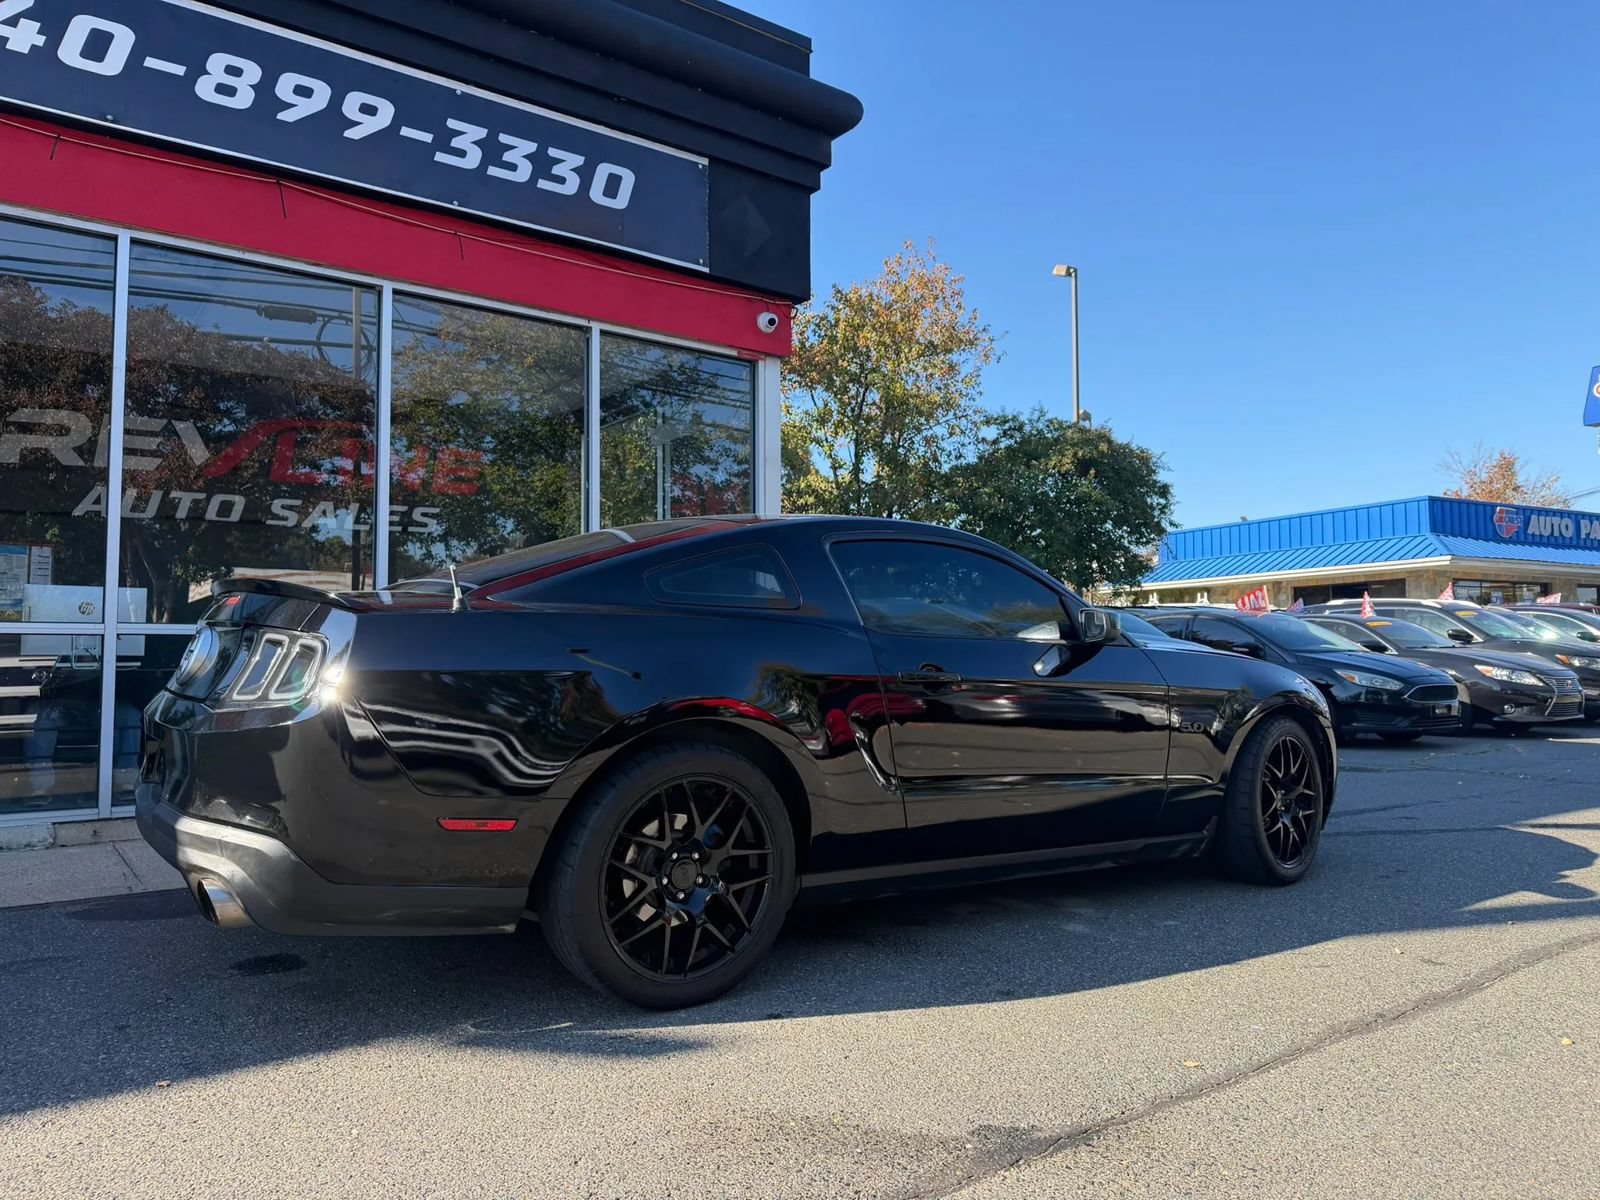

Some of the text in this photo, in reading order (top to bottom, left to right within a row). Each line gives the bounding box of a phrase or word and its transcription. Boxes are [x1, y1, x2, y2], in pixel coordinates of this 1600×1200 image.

[71, 484, 441, 533] AUTO SALES
[1527, 514, 1574, 538] AUTO
[1180, 721, 1205, 732] 5.0
